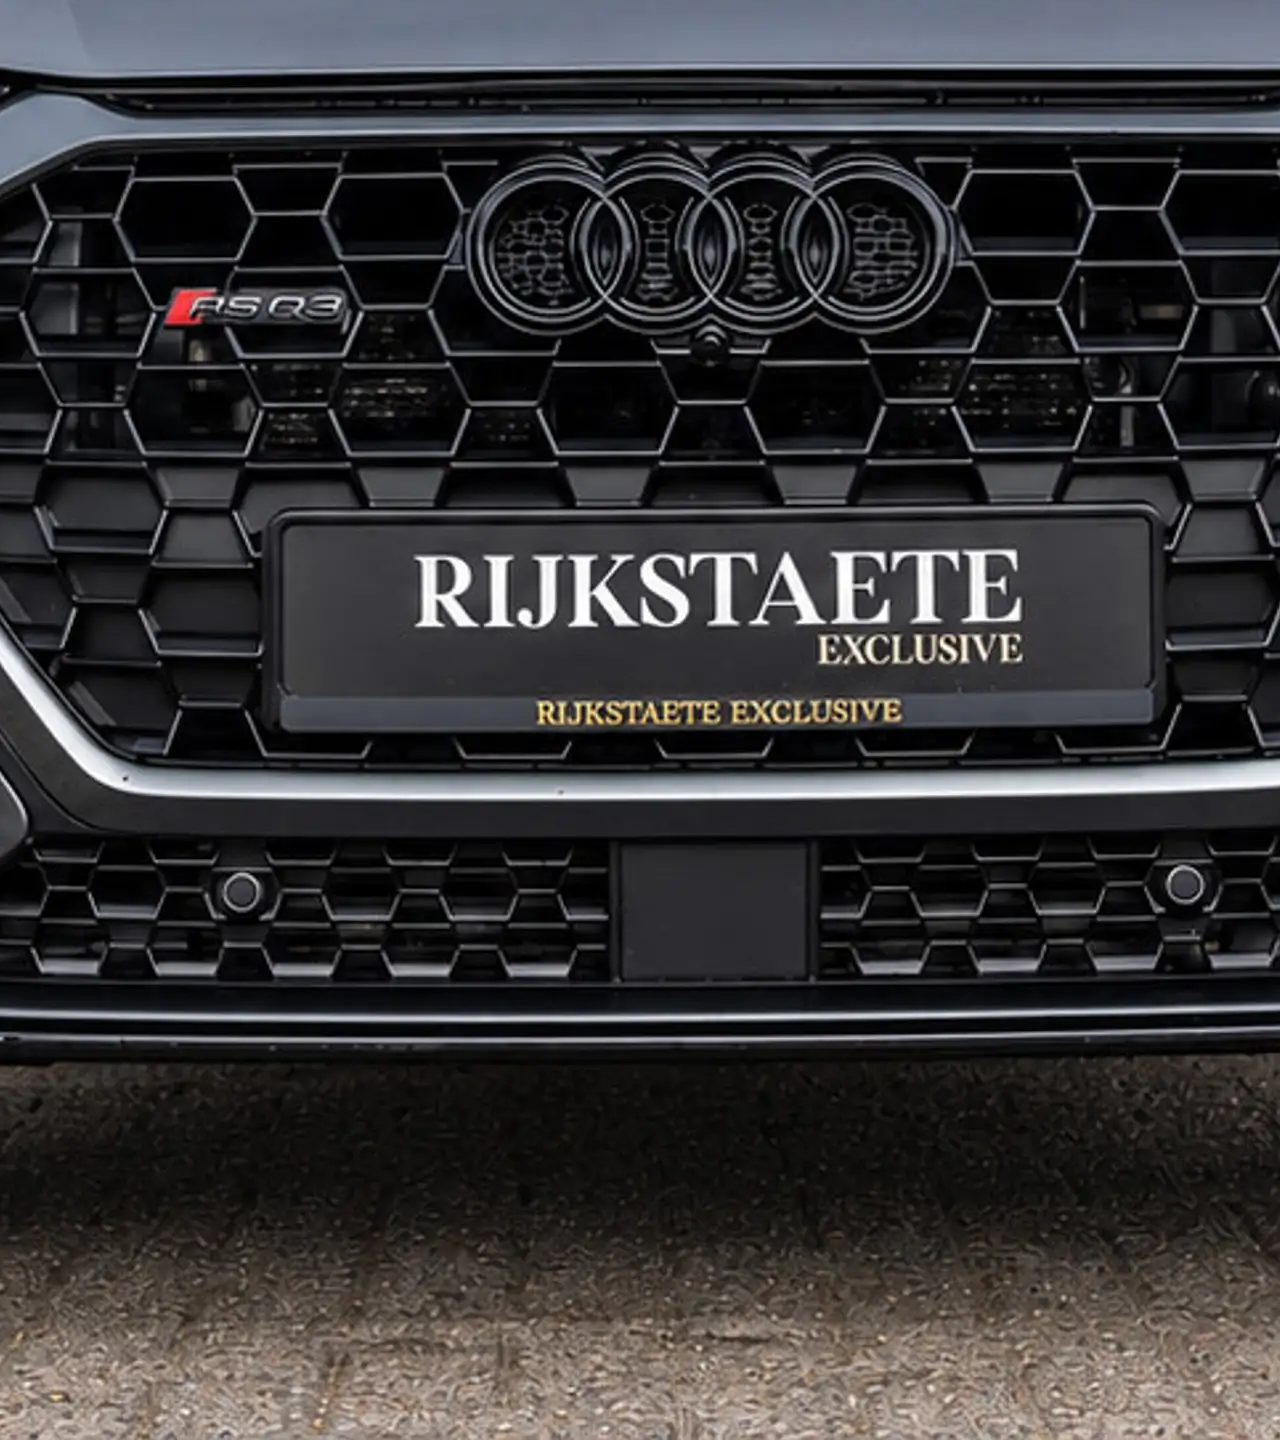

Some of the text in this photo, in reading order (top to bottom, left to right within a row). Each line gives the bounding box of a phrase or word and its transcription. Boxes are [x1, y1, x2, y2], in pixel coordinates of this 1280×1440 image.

[415, 548, 1023, 630] RIJKSTAETE
[817, 633, 1024, 666] EXCLUSIVE
[536, 698, 903, 727] RIJKSTAETE EXCLUSIVE
